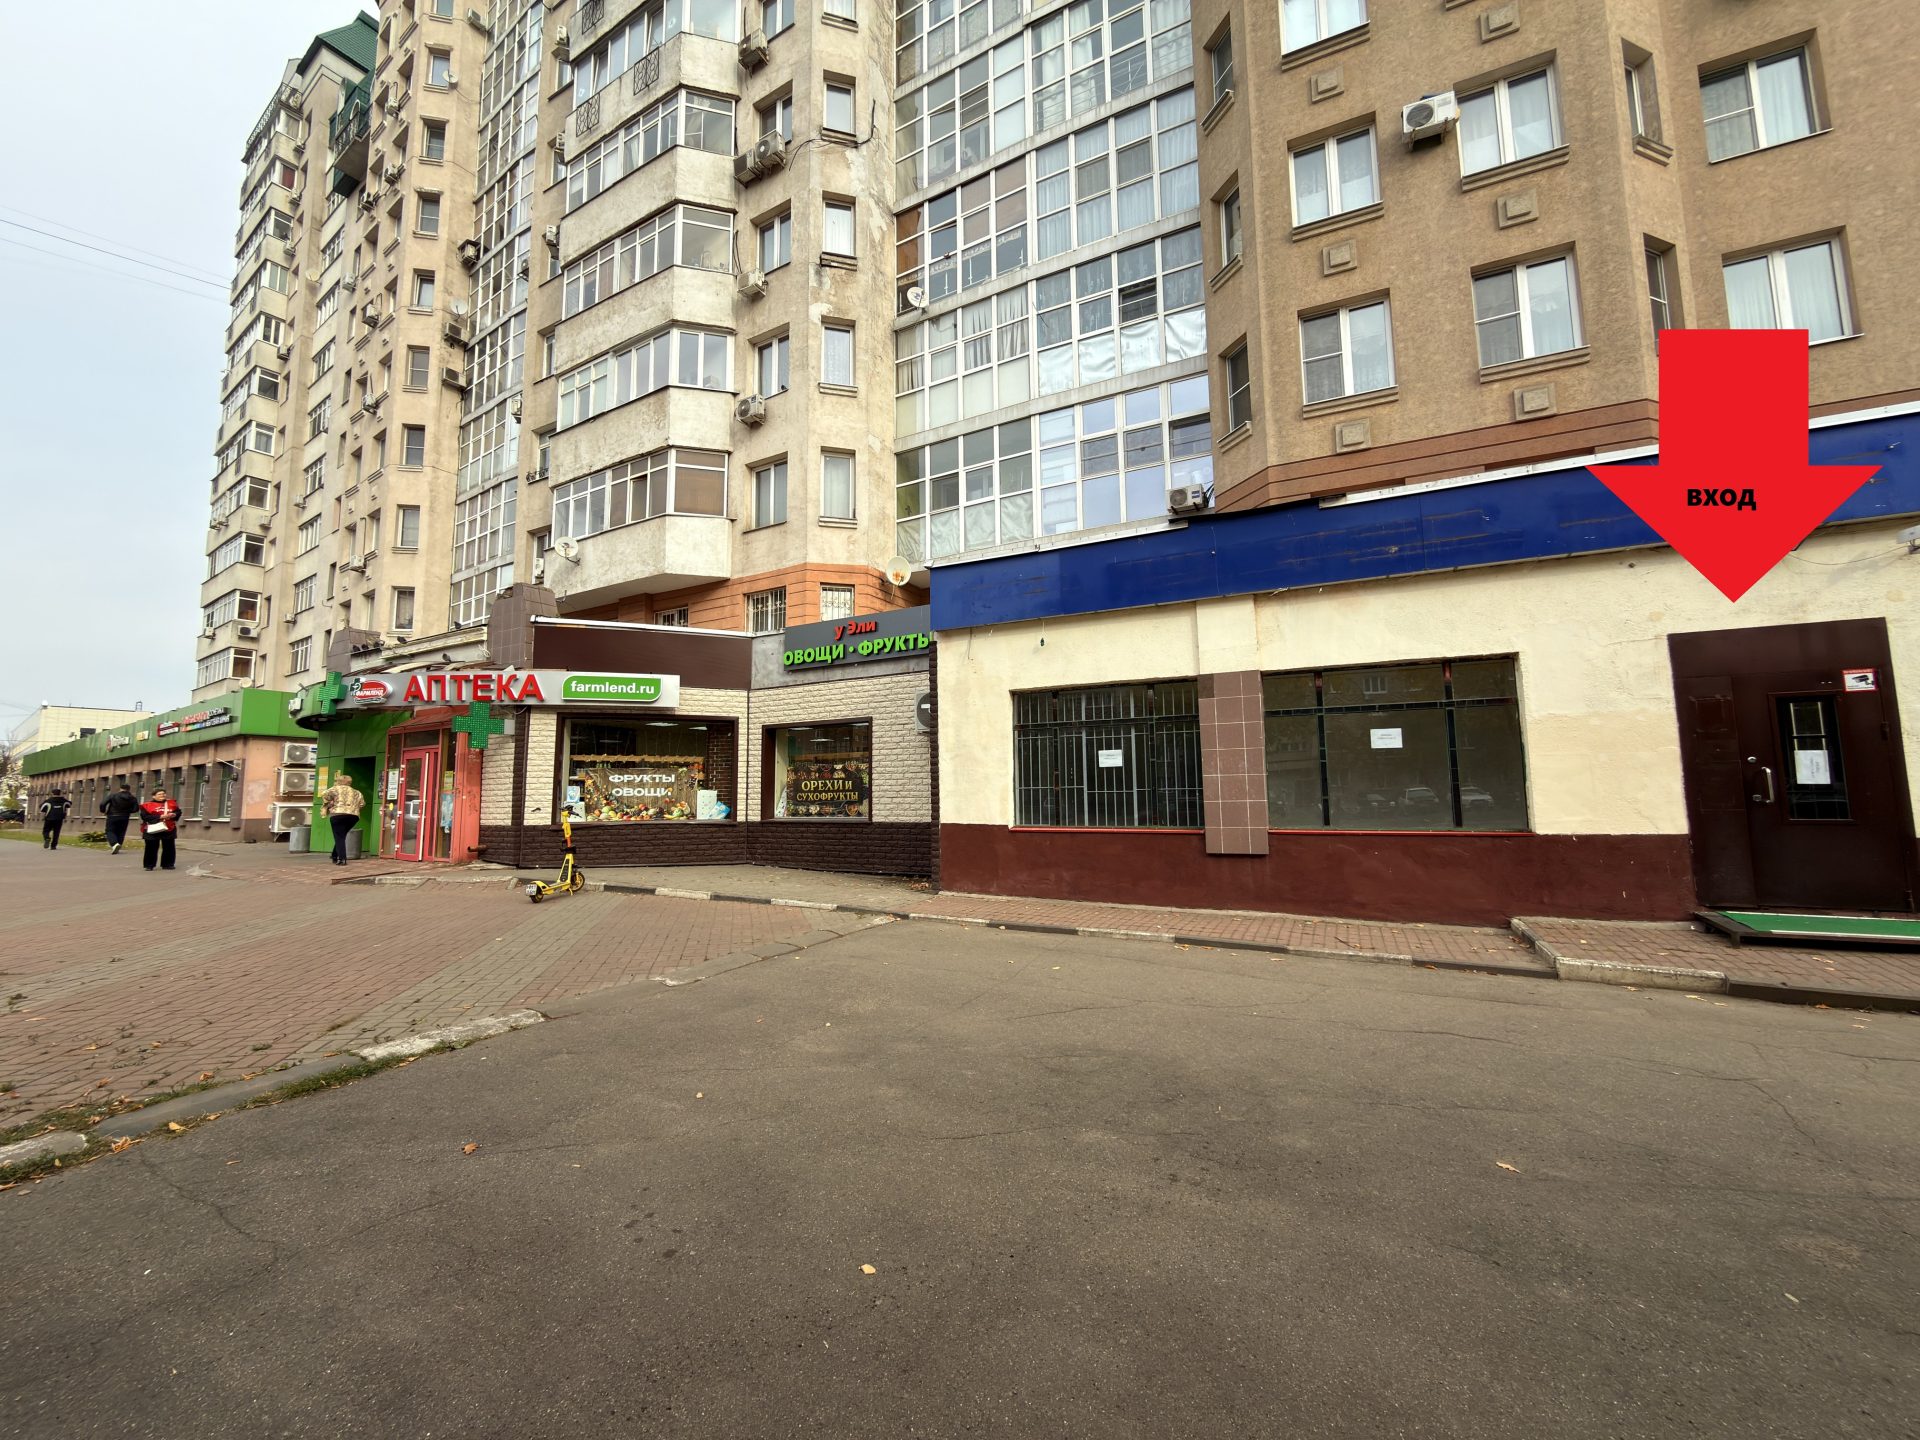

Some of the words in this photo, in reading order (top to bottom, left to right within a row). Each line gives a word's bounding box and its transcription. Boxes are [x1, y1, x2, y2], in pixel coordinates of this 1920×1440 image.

[847, 620, 877, 635] Эли
[783, 643, 845, 666] ОВОЩИ
[857, 631, 933, 656] ФРУКТЫ
[403, 673, 545, 702] АПТЕКА
[570, 680, 655, 694] farmlend.ru
[608, 773, 676, 783] ФРУКТЫ
[801, 779, 843, 791] ОРЕХИ
[611, 787, 672, 798] ОВОЩИ
[796, 791, 859, 801] СУХОФРУКТЫ
